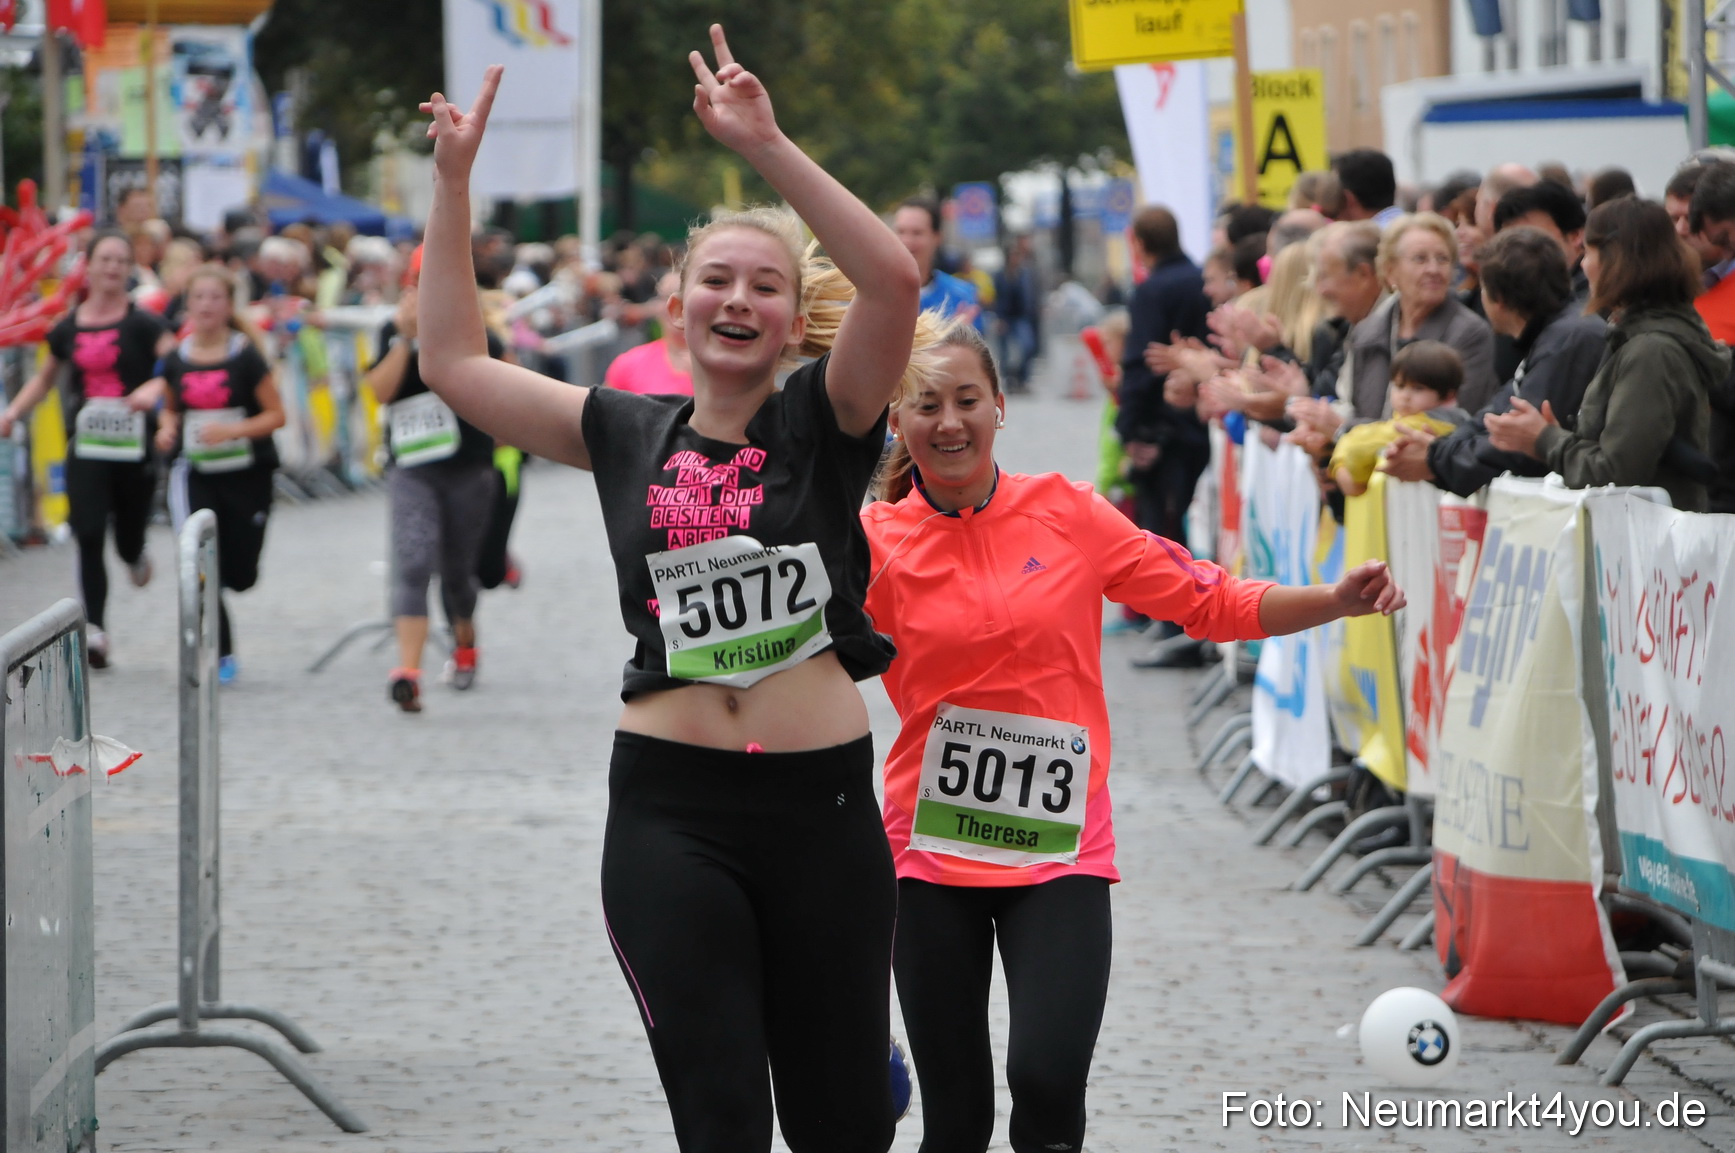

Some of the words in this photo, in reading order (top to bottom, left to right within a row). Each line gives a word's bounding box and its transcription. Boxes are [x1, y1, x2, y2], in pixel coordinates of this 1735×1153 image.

[1135, 9, 1183, 34] lauf
[1257, 111, 1303, 174] A
[647, 485, 711, 504] NICHT
[723, 487, 762, 504] DIE
[652, 506, 748, 526] BESTEN,
[655, 559, 706, 583] PARTL
[676, 558, 817, 638] 5072
[713, 635, 796, 670] Kristina
[933, 716, 986, 737] PARTL
[990, 726, 1066, 750] Neumarkt
[938, 741, 1074, 814] 5013
[956, 813, 1039, 847] Theresa
